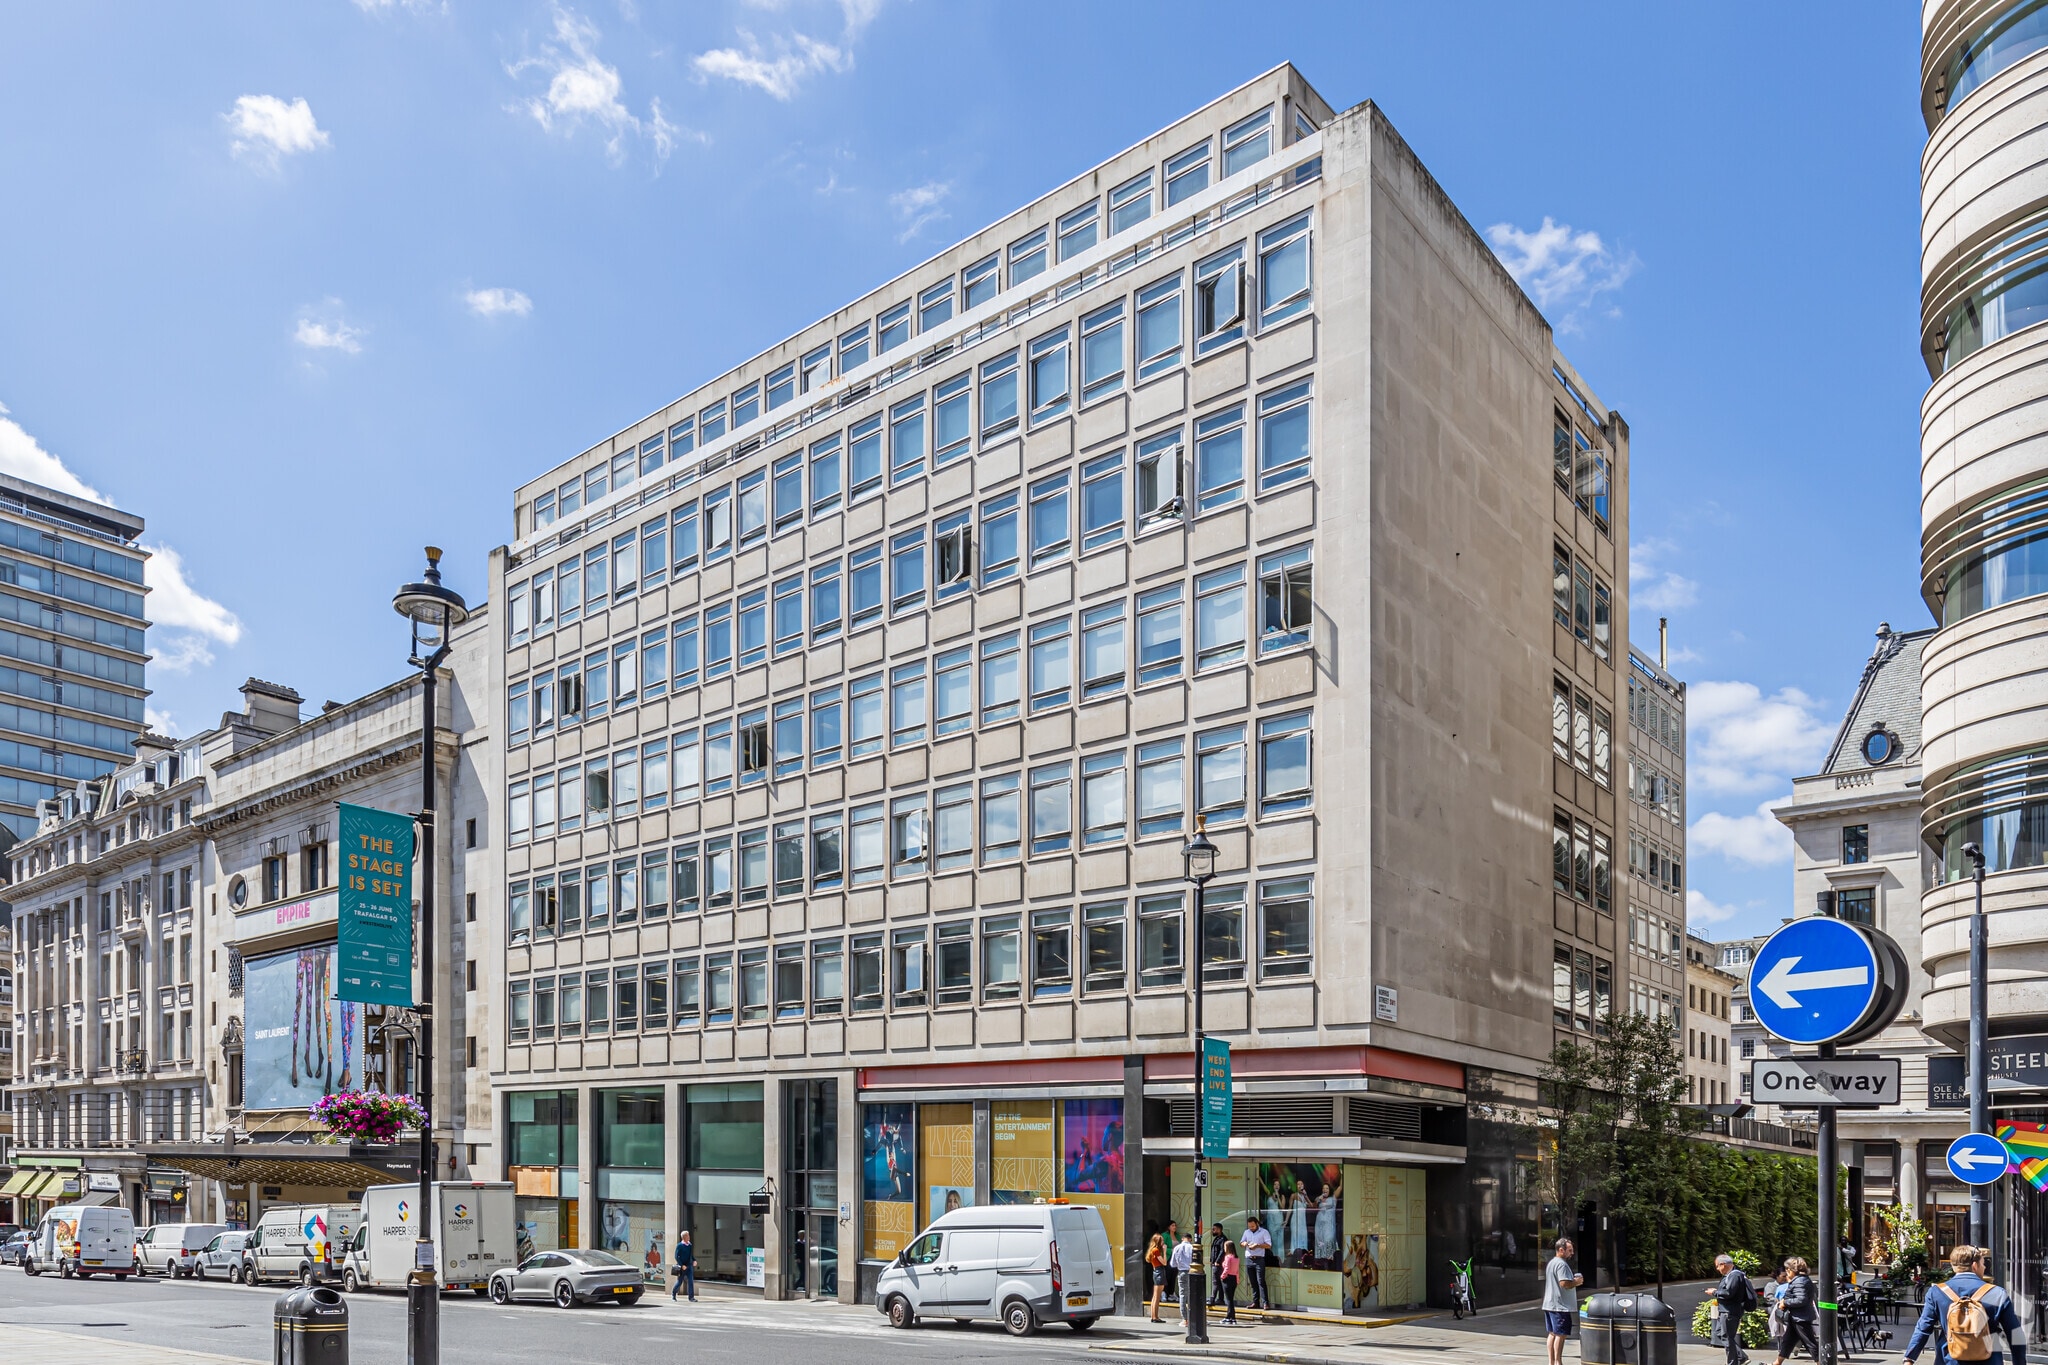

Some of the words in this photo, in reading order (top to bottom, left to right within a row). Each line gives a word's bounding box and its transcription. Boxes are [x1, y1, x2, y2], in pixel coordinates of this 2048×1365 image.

[359, 833, 394, 855] THE
[348, 853, 404, 877] STAGE
[348, 874, 366, 891] IS
[371, 878, 402, 898] SET
[276, 901, 311, 925] EMPIRE
[378, 906, 393, 914] JUNE
[353, 909, 388, 921] TRAFALGAR
[389, 914, 398, 923] SQ
[254, 1028, 269, 1040] SAINT
[268, 1026, 291, 1038] LAURENT
[1208, 1054, 1226, 1067] WEST
[1210, 1068, 1224, 1078] END
[1209, 1081, 1226, 1091] LIVE
[1762, 1070, 1817, 1091] One
[1830, 1075, 1888, 1095] way
[1933, 1085, 1952, 1093] OLE
[1958, 1085, 1965, 1093] &
[1933, 1092, 1965, 1100] STEEN
[994, 1113, 1007, 1121] LET
[994, 1122, 1051, 1131] ENTERTAINMENT
[994, 1132, 1016, 1141] BEGIN
[266, 1227, 288, 1238] HARPER
[383, 1226, 407, 1236] HARPER
[407, 1225, 419, 1236] SIG
